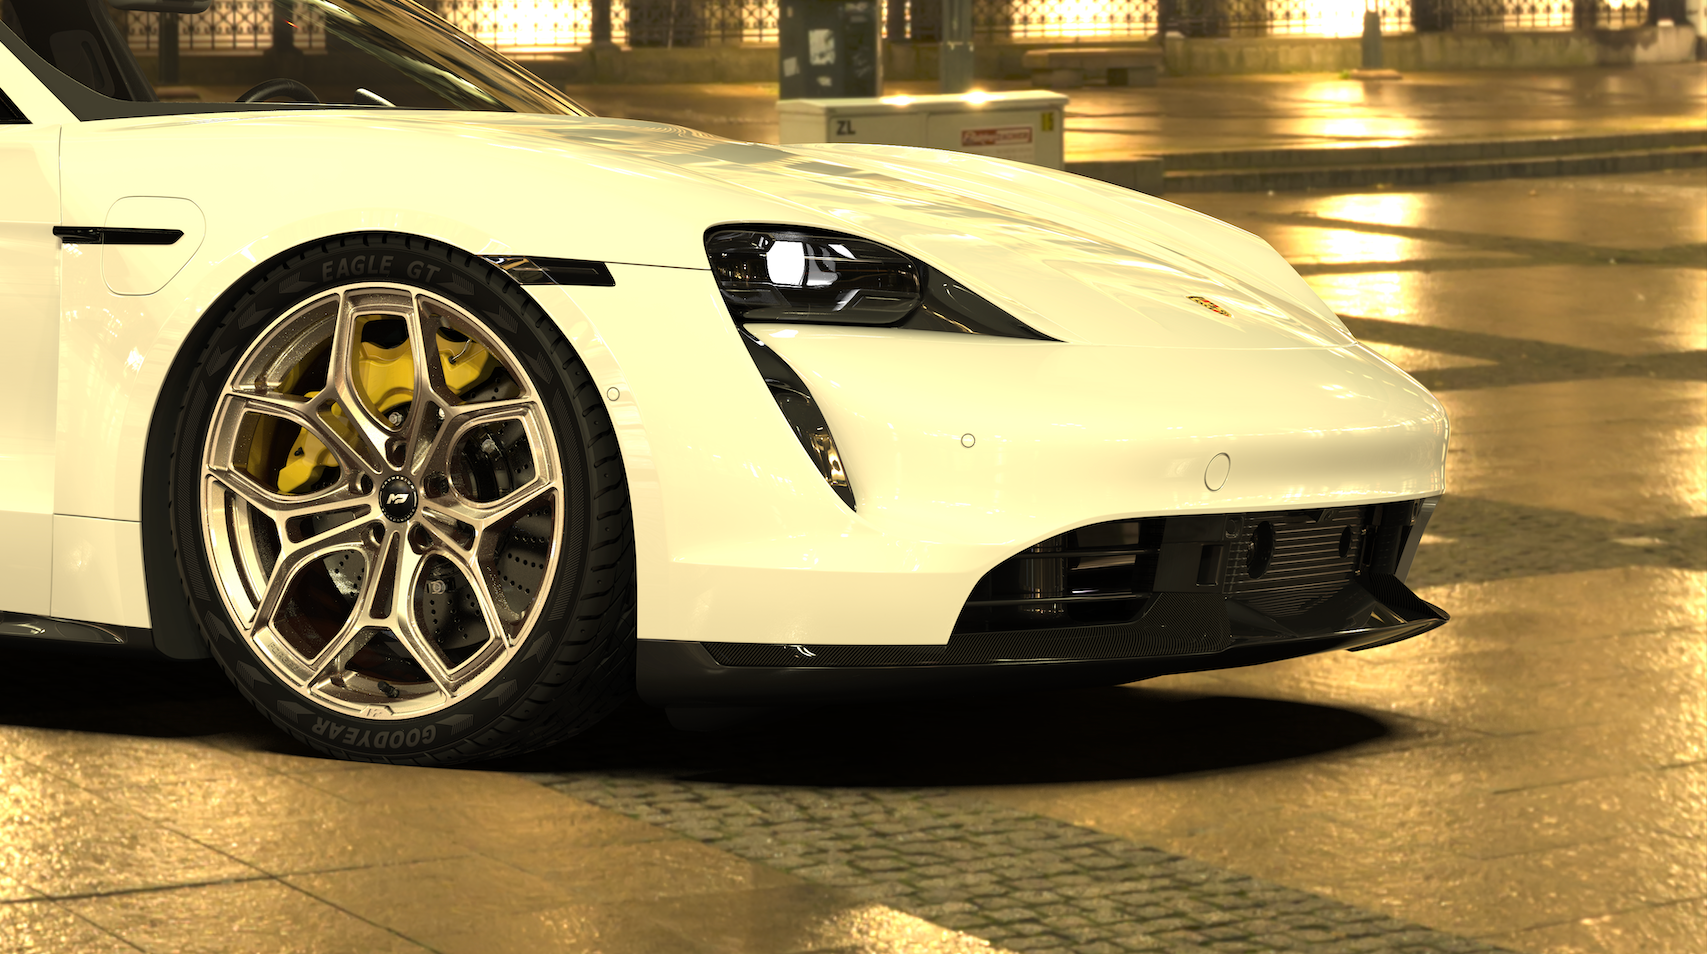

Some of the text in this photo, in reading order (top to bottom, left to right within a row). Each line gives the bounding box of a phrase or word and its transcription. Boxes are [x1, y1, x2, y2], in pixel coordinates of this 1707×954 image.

[836, 120, 856, 136] ZL
[322, 255, 441, 283] EAGLE GT
[311, 716, 437, 749] GOODYEAR
